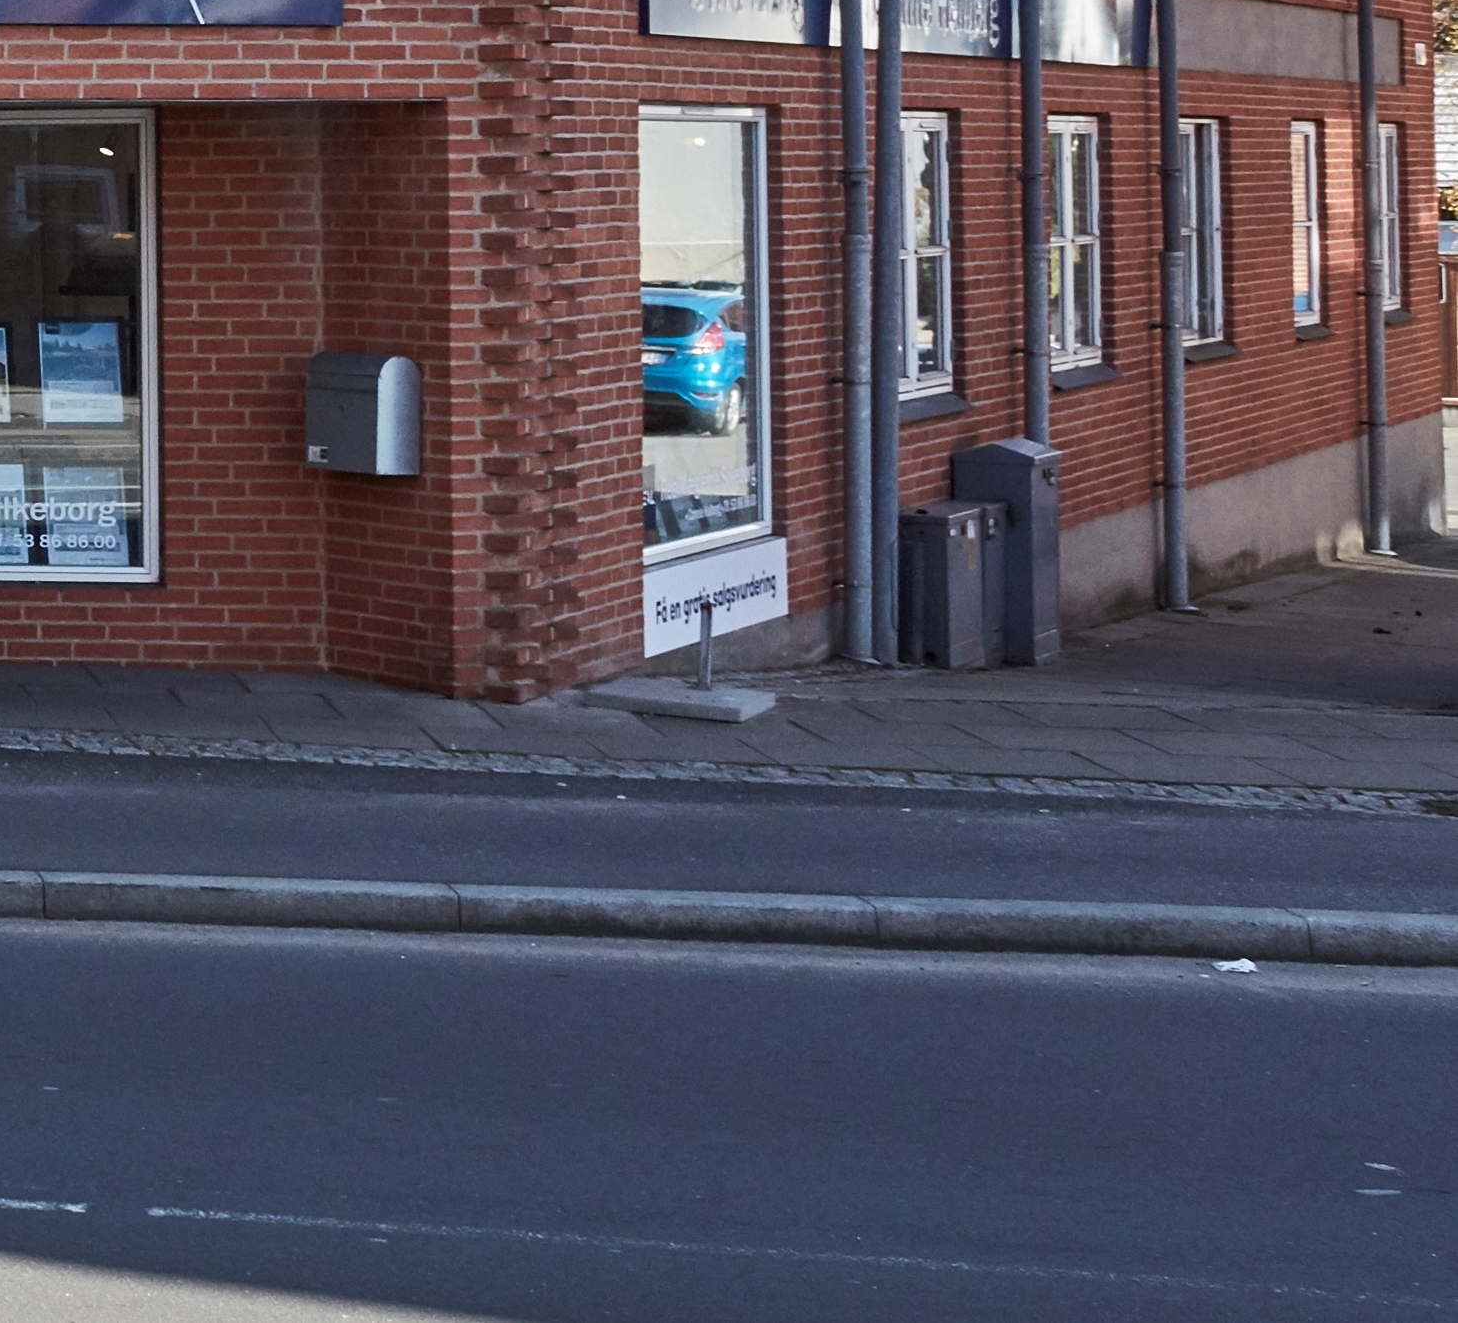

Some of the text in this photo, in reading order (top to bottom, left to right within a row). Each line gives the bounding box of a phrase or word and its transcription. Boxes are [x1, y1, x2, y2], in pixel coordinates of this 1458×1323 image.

[13, 534, 35, 547] 53
[39, 534, 62, 548] 86
[66, 535, 89, 548] 86
[93, 535, 117, 549] 00
[670, 602, 681, 621] en
